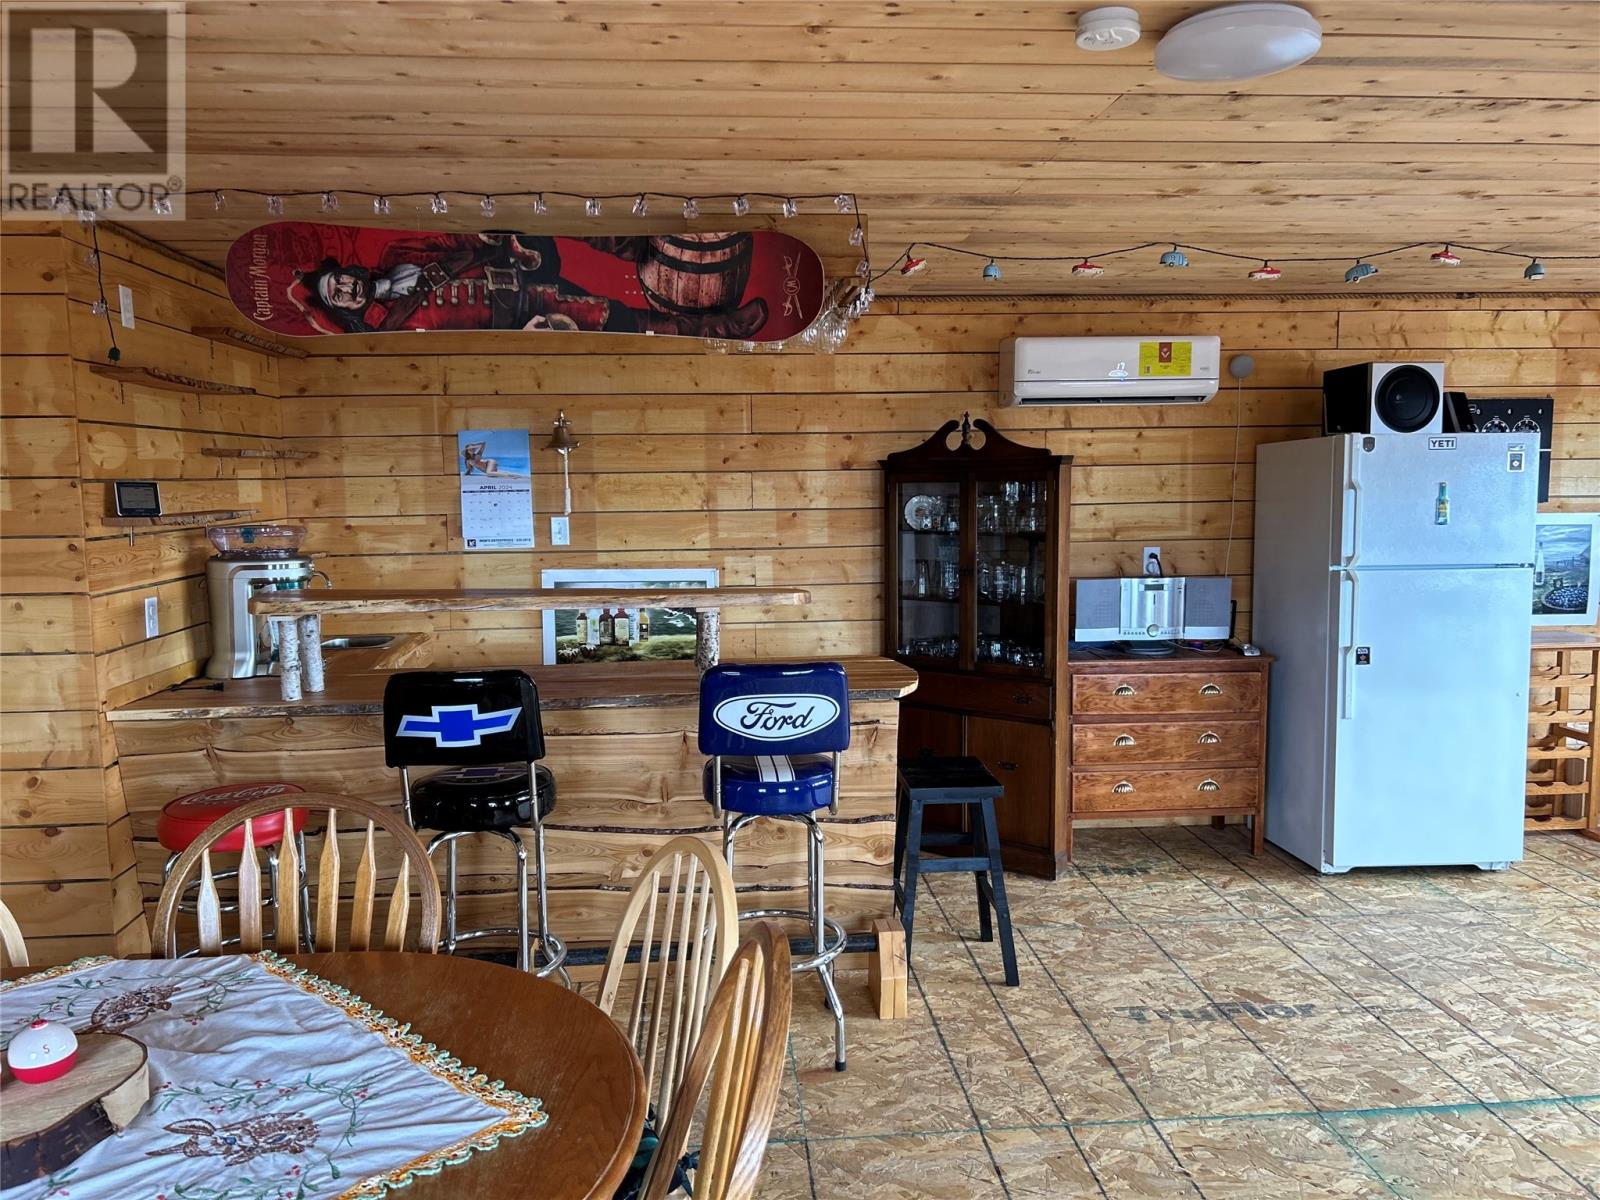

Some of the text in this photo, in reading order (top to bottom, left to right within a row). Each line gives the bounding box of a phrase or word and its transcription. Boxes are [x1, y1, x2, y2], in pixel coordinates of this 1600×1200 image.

[249, 234, 274, 321] Captain Morgan
[1430, 439, 1455, 448] YETI
[740, 701, 815, 731] Ford
